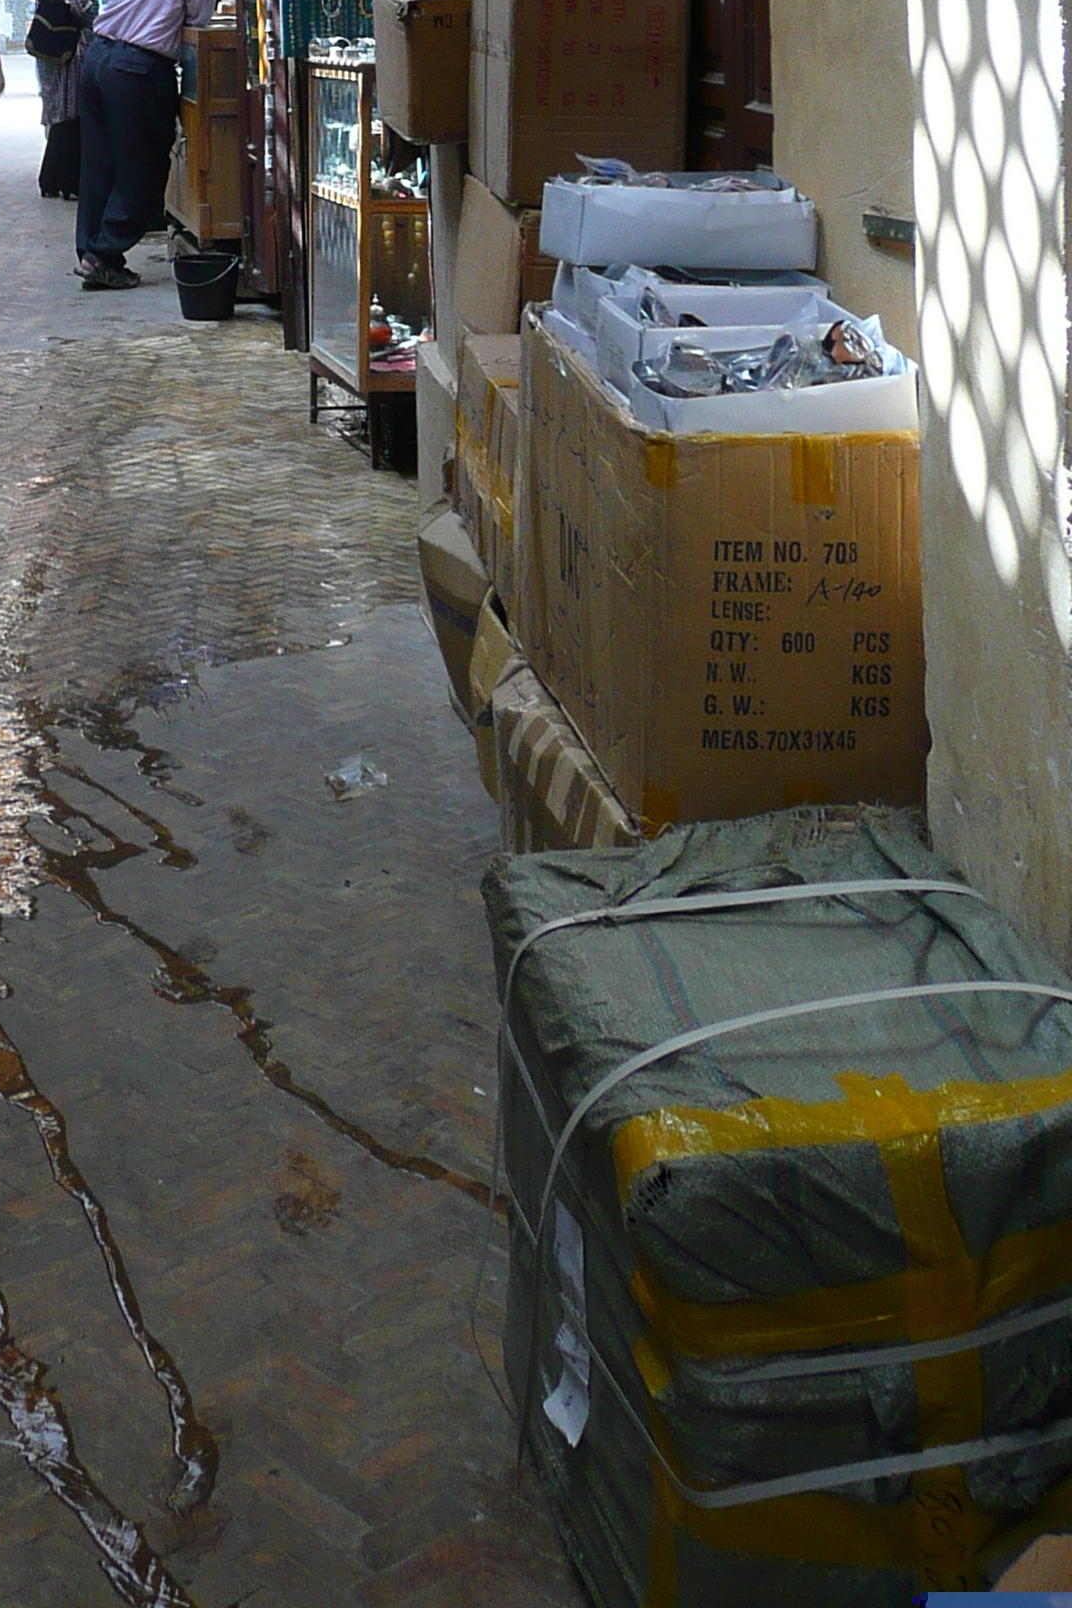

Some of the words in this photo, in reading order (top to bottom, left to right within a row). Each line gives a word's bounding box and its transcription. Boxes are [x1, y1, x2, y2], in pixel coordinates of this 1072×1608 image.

[714, 540, 763, 563] ITEM
[774, 541, 808, 563] NO.
[823, 542, 858, 564] 708
[712, 571, 792, 593] FRAME:
[711, 600, 770, 622] LENSE:
[710, 629, 759, 652] QTY:
[781, 632, 816, 653] 600
[853, 631, 891, 654] PCS
[852, 664, 892, 685] KGS
[850, 696, 891, 717] KGS
